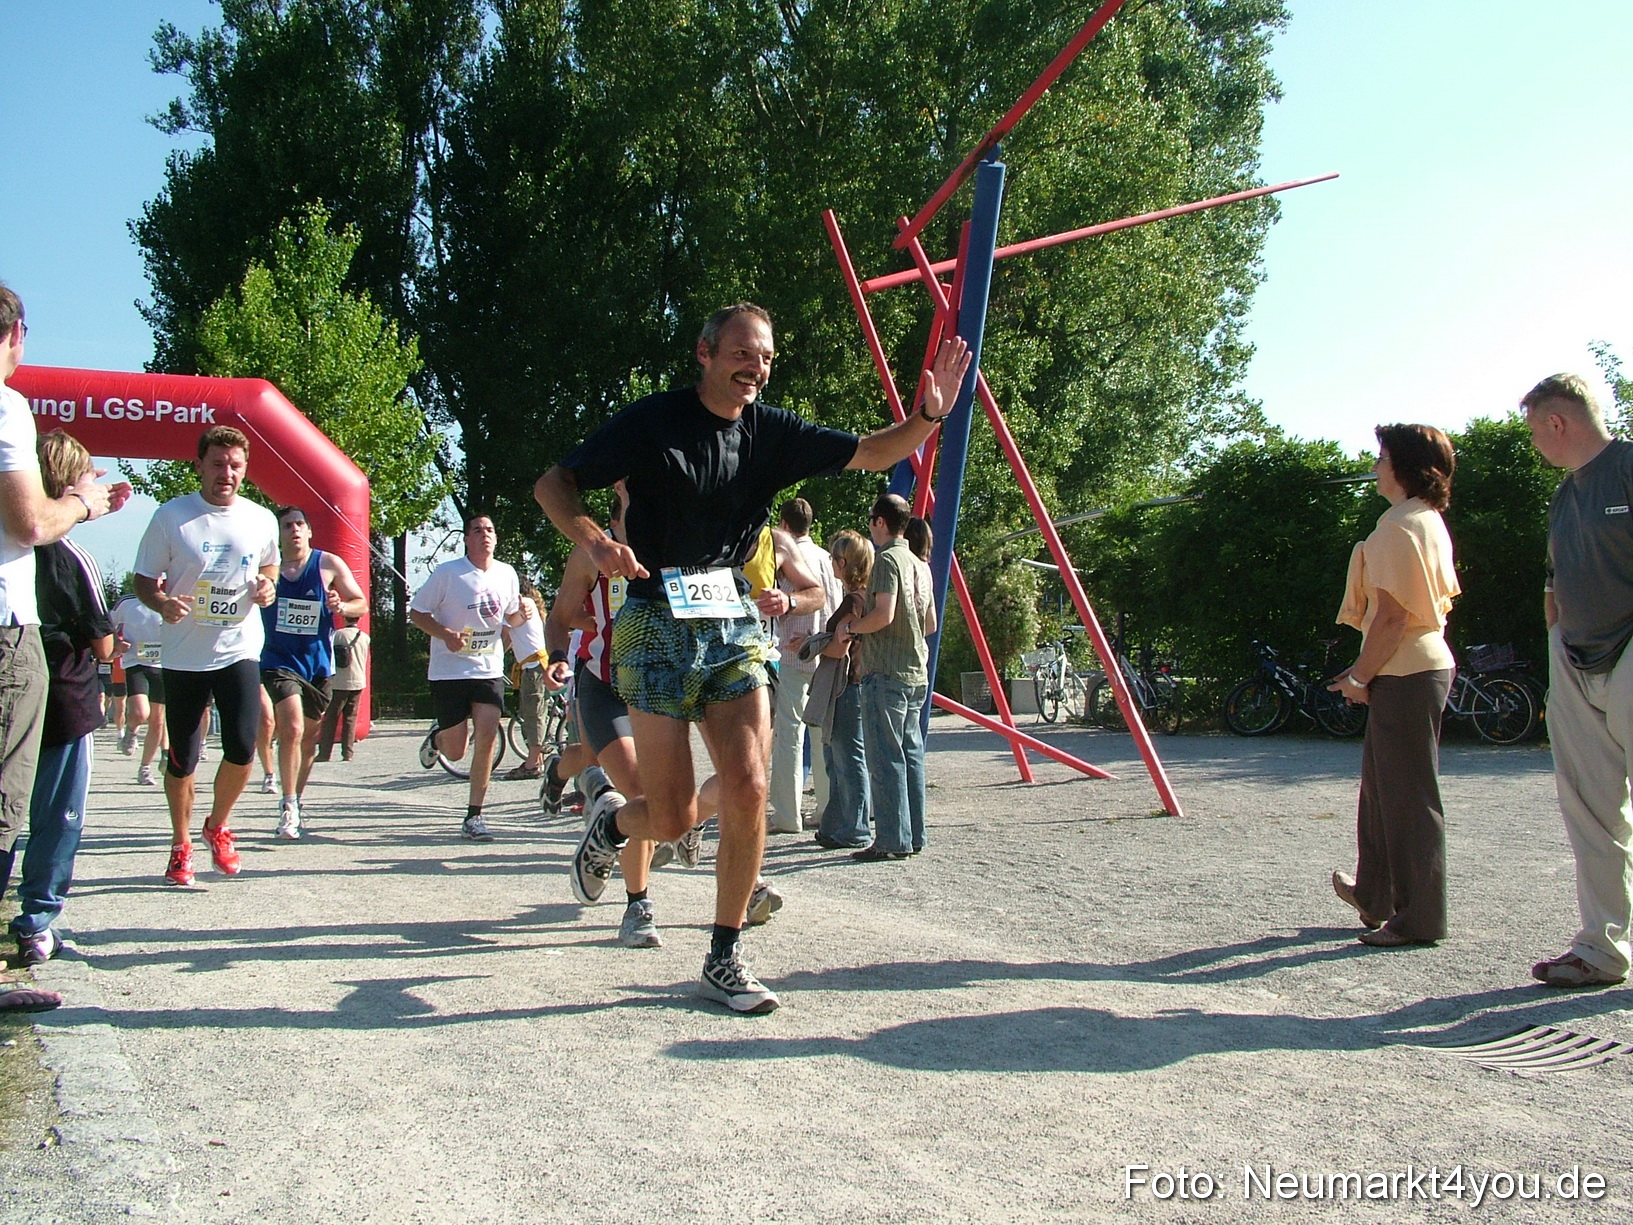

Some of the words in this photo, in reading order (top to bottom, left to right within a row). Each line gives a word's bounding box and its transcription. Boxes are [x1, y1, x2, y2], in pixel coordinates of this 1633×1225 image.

[86, 396, 216, 424] LGS-Park
[210, 585, 237, 596] Rainer
[612, 584, 620, 594] B
[669, 582, 679, 592] B
[687, 583, 735, 602] 2632
[198, 596, 205, 605] B
[210, 600, 238, 615] 620
[288, 602, 312, 611] Manuel
[287, 613, 317, 625] 2687
[471, 639, 489, 650] 873
[145, 650, 160, 658] 399
